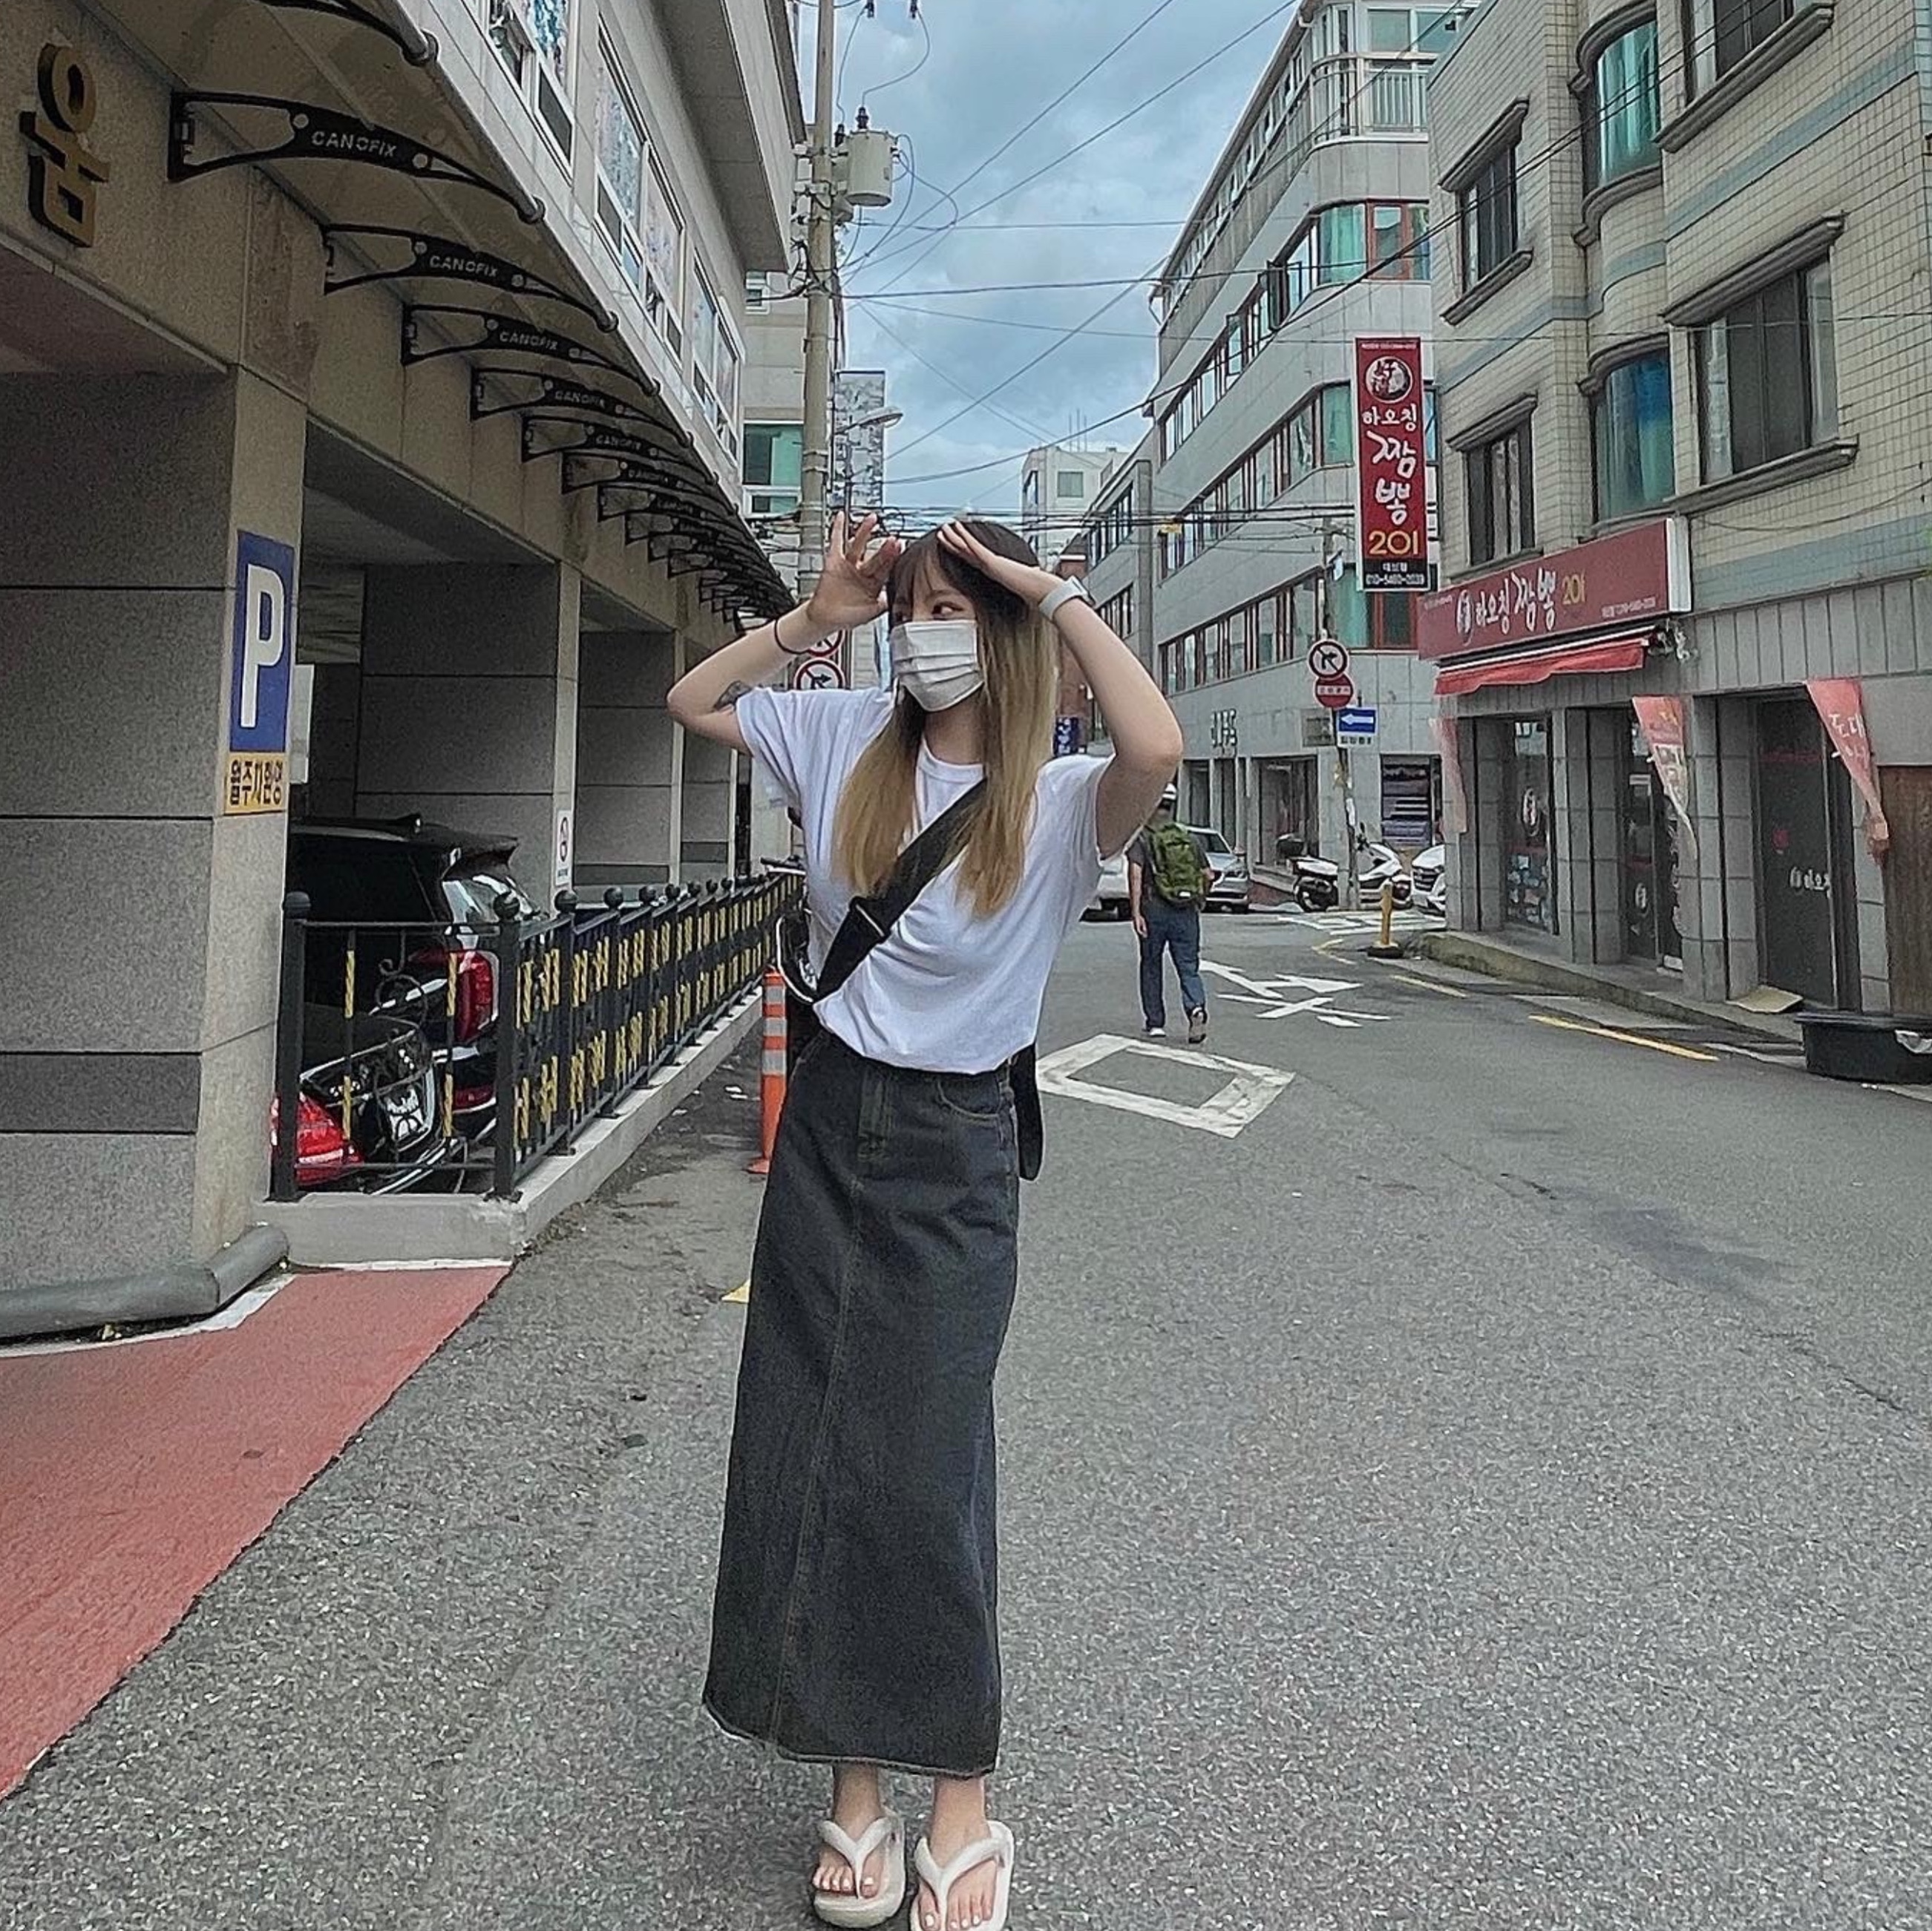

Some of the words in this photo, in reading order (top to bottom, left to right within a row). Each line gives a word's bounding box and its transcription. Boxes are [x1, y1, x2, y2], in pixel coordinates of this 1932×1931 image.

[311, 131, 398, 158] CANOFIX
[429, 255, 498, 278] CANOFIX
[1369, 531, 1419, 555] 201
[1562, 569, 1587, 605] 201
[240, 563, 284, 728] P
